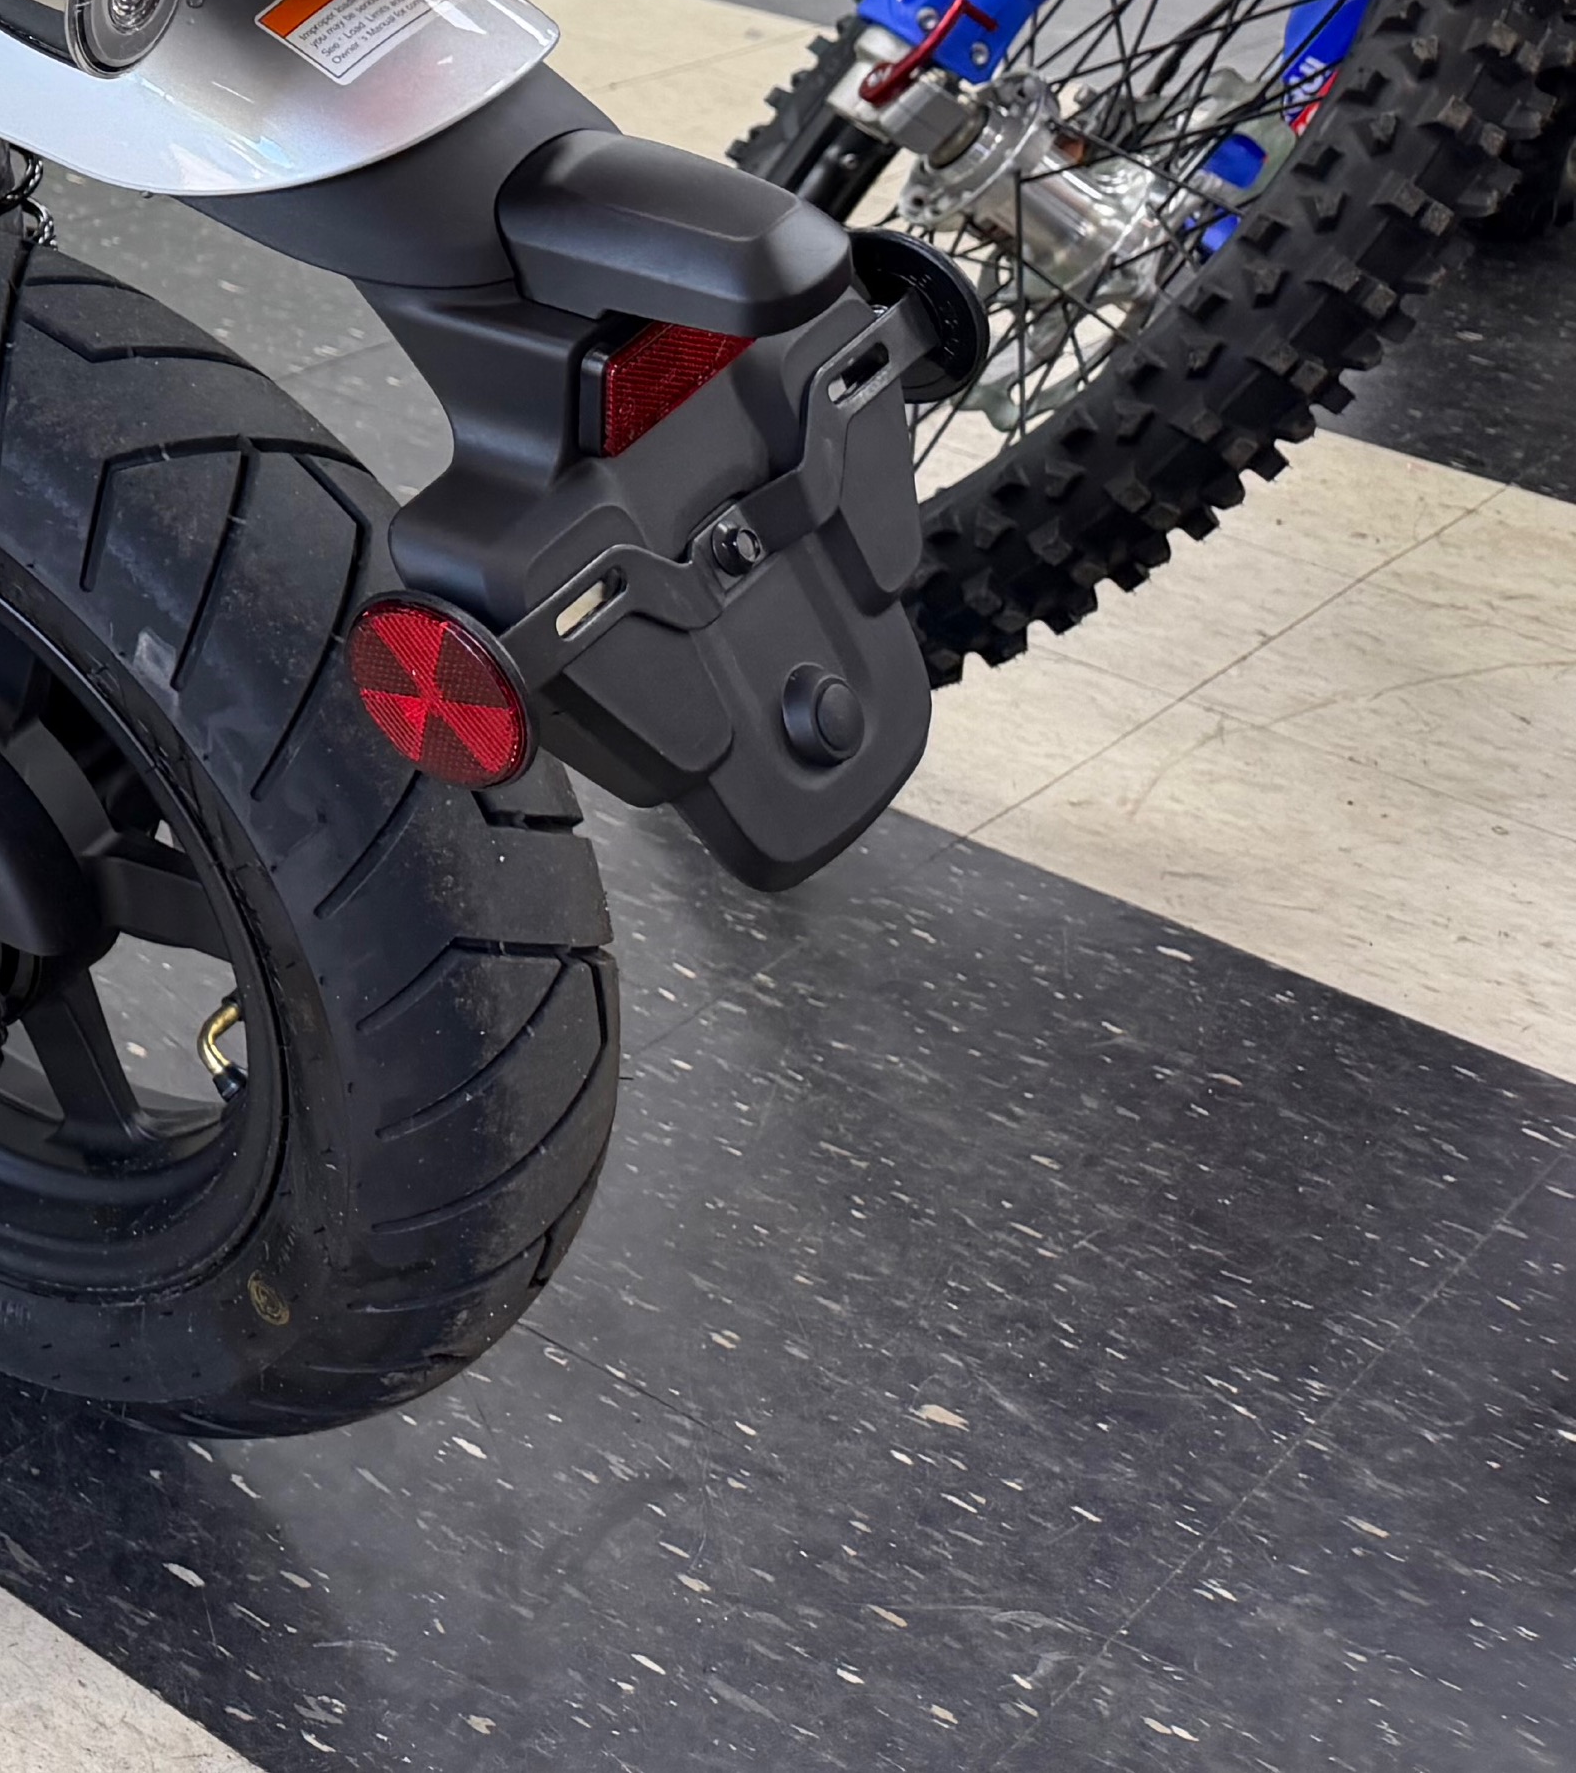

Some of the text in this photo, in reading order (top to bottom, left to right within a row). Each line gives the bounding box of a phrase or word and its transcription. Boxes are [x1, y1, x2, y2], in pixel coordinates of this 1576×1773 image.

[298, 11, 336, 41] Improper
[309, 34, 327, 49] you
[327, 20, 346, 35] may
[342, 12, 356, 22] be
[366, 15, 396, 37] Manual
[321, 42, 341, 57] See
